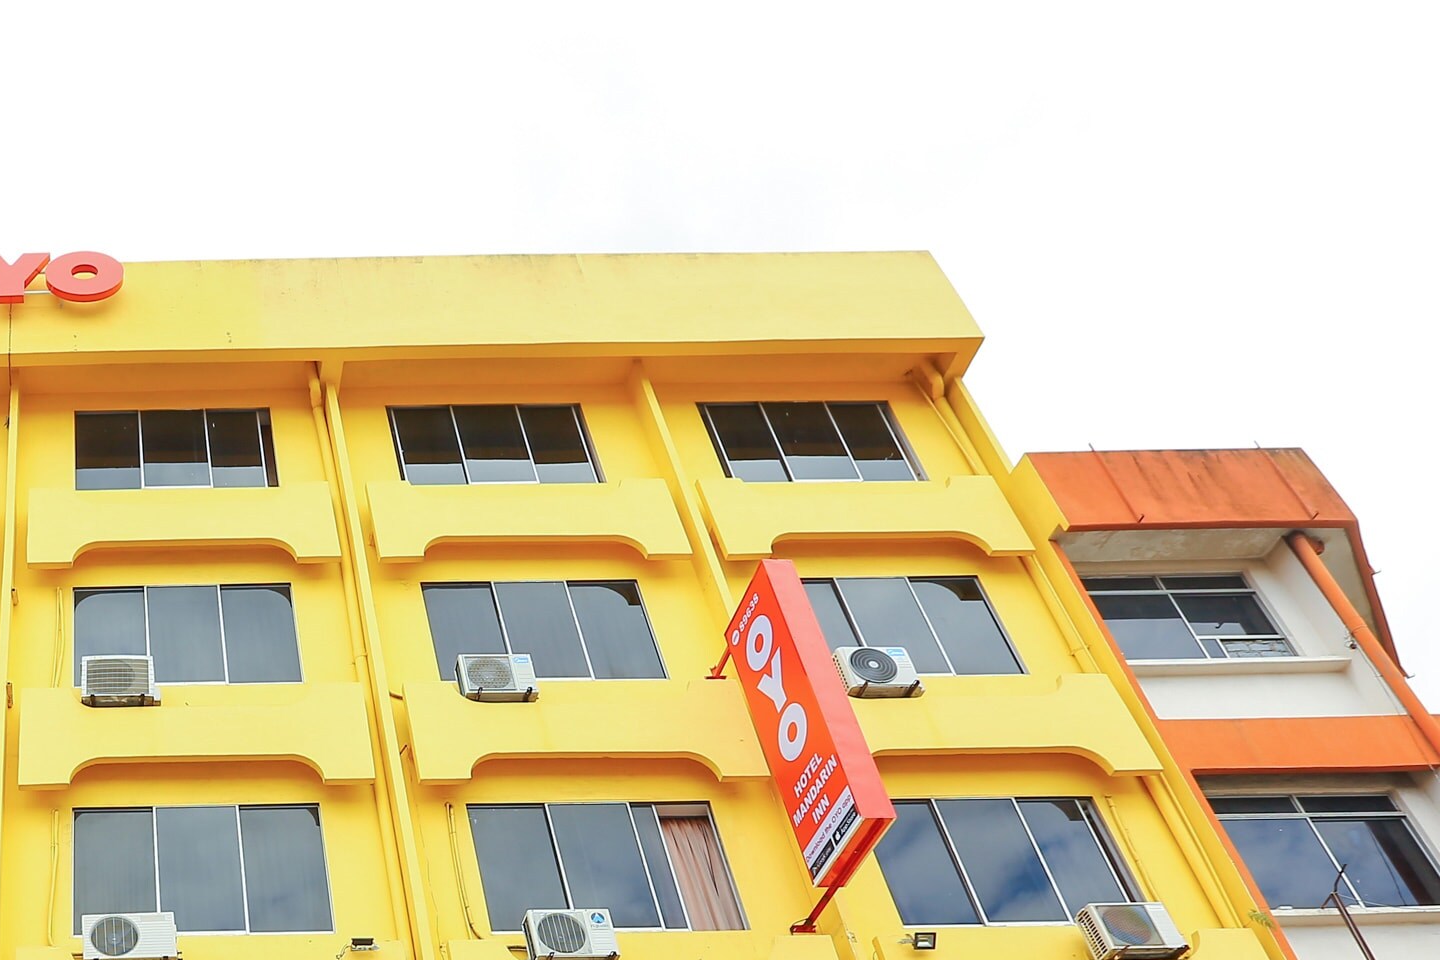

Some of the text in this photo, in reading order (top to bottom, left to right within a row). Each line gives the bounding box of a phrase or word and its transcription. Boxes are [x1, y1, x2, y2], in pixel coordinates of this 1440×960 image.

[746, 614, 808, 762] OYO
[793, 754, 838, 827] MANDARIN
[794, 753, 822, 798] HOTEL
[811, 794, 830, 824] INN
